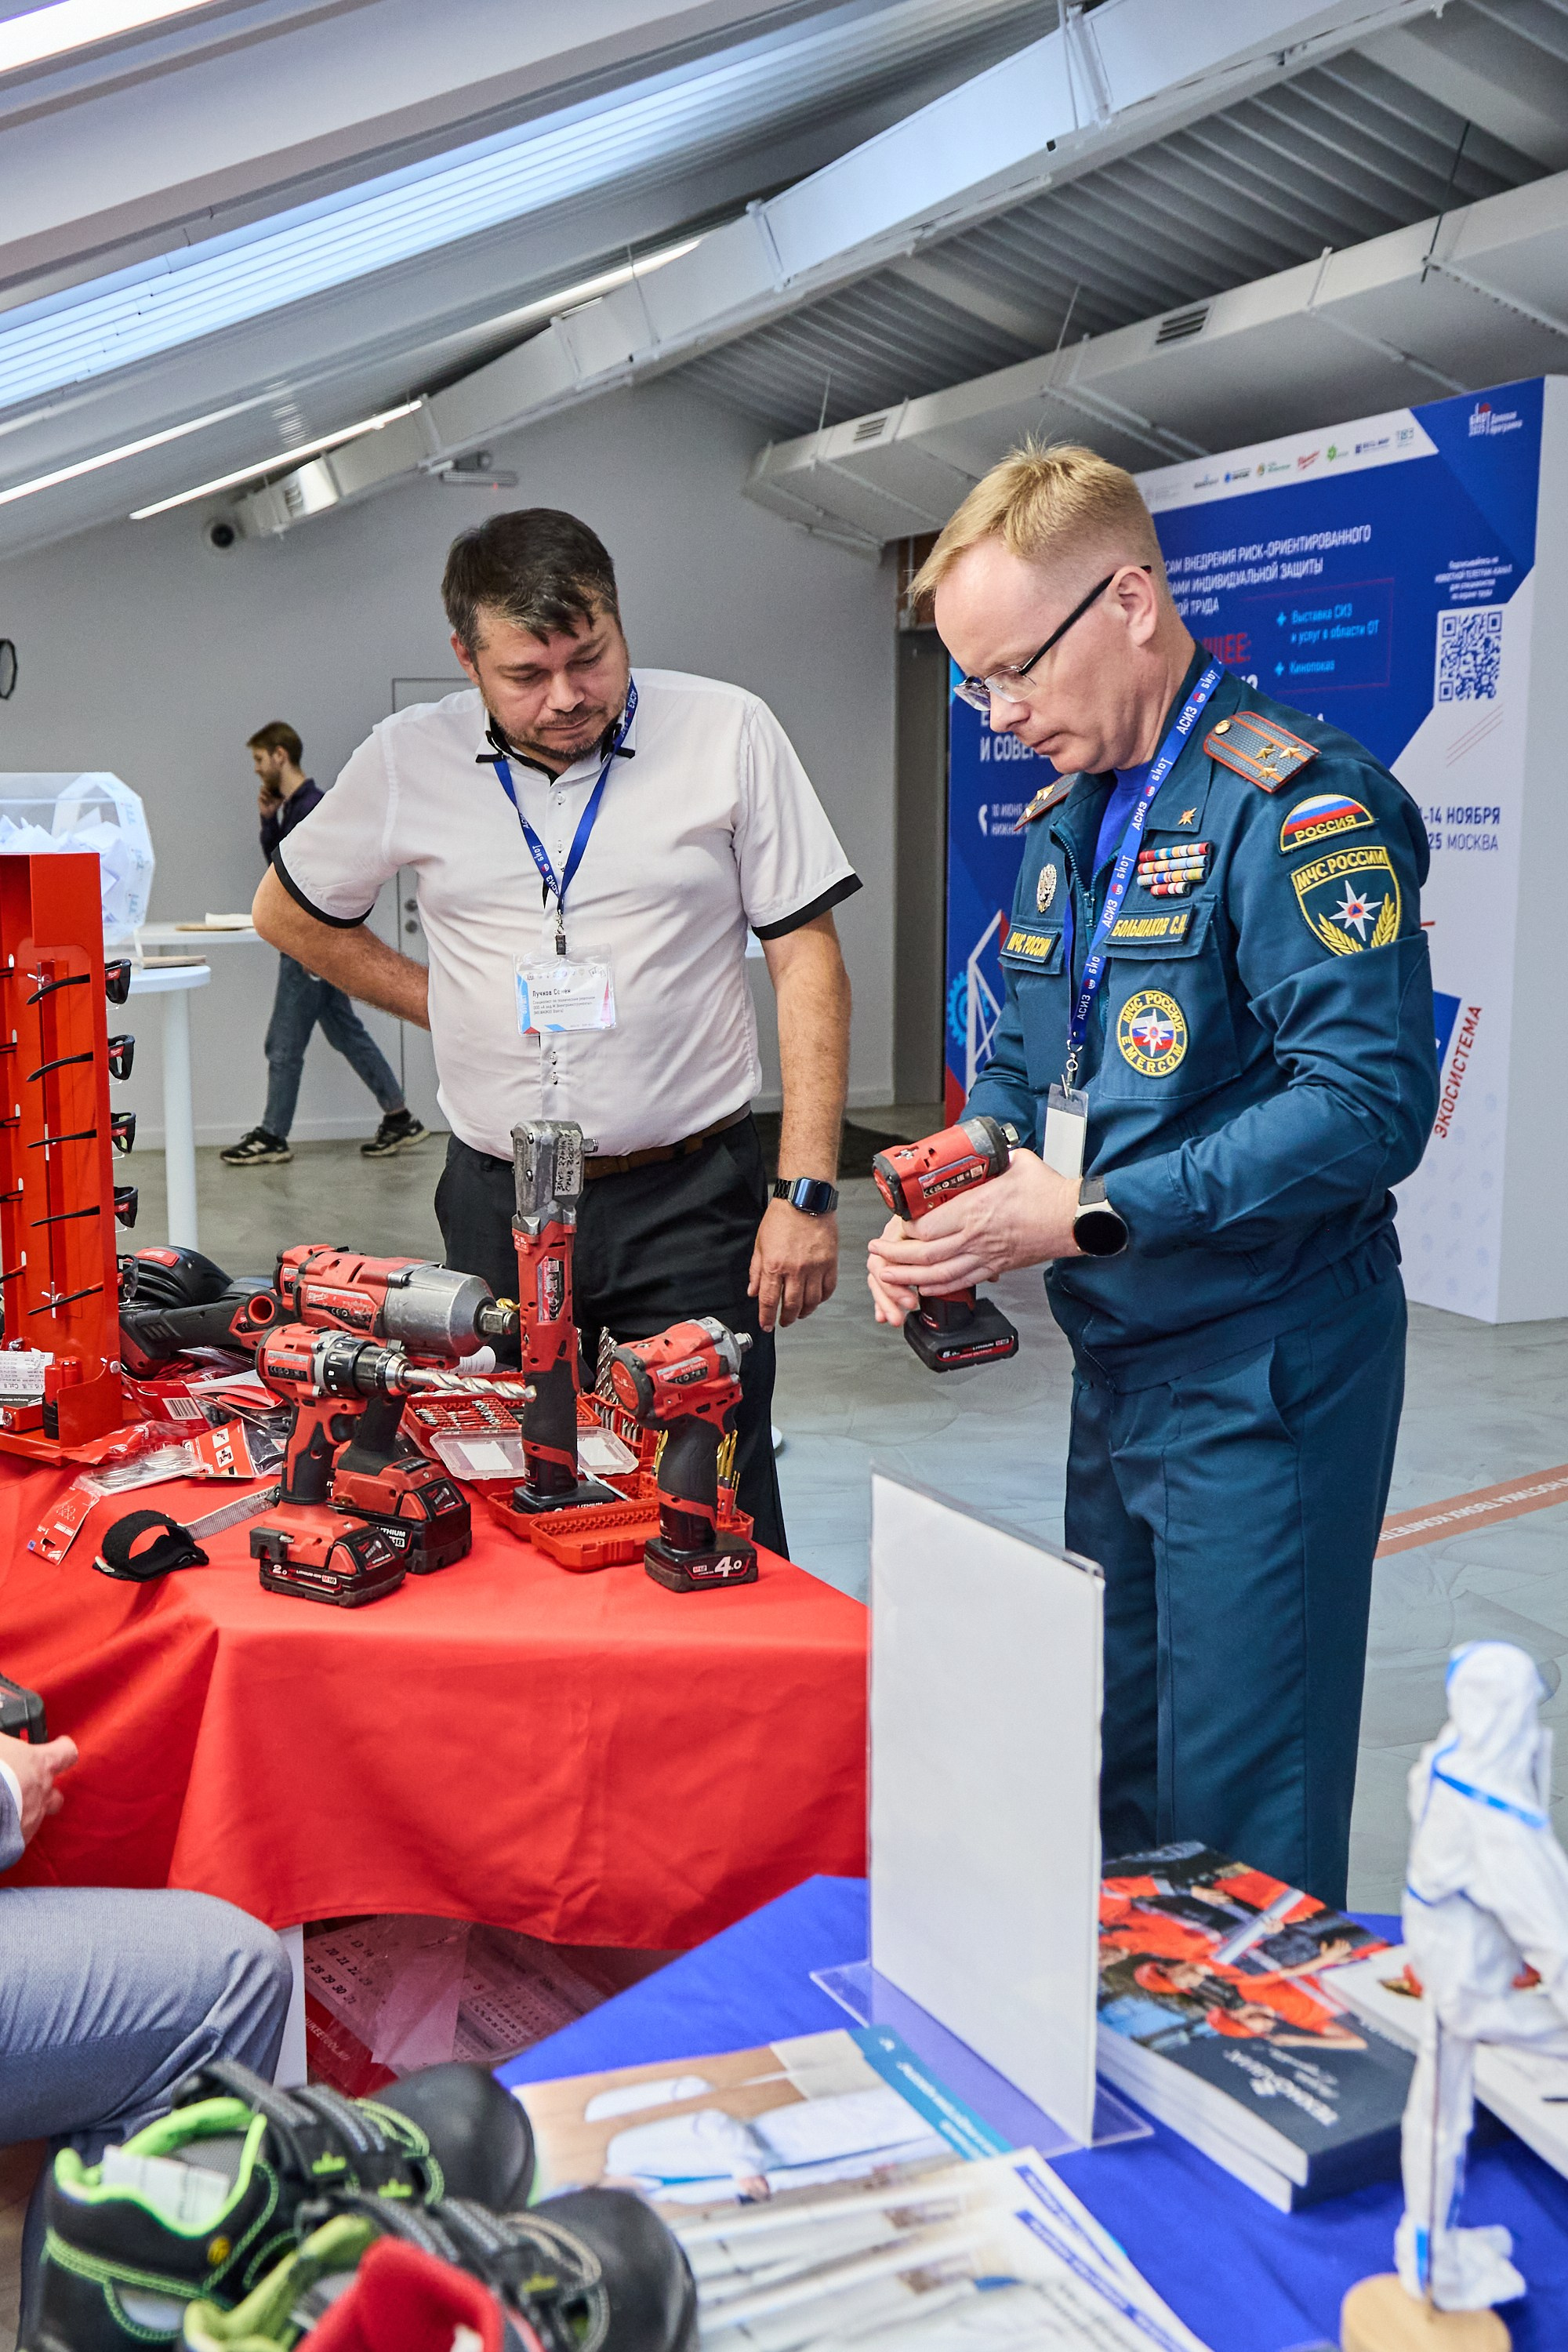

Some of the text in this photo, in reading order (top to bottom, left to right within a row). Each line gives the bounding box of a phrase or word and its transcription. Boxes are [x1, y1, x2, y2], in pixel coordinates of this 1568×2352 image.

[1185, 550, 1237, 573] ВНЕДРЕНИЯ
[1238, 524, 1372, 564] РИСК-ОРИЕНТИРОВАННОГО
[1192, 561, 1279, 593] ИНДИВИДУАЛЬНОЙ
[1279, 557, 1324, 582] ЗАЩИТЫ
[1190, 597, 1220, 616] ТРУДА
[1291, 603, 1354, 624] Выставка СИЗ
[1290, 659, 1336, 674] Кинопоказ
[1176, 706, 1198, 735] АСИЗ
[1131, 800, 1148, 831] АСИЗ
[1294, 814, 1356, 843] РОССИЯ
[1446, 806, 1501, 825] НОЯБРЯ
[1447, 833, 1499, 851] МОСКВА
[1296, 849, 1388, 891] МЧС РОССИИ
[1102, 898, 1119, 929] АСИЗ
[1111, 916, 1171, 938] БОЛЬШАКОВ
[1076, 994, 1091, 1021] АСИЗ
[1122, 993, 1184, 1033] МЧС РОССИИ
[1121, 1035, 1183, 1073] EMERCOM
[1434, 1005, 1483, 1138] ЭКОСИСТЕМА
[272, 1564, 287, 1576] 2.0
[714, 1555, 742, 1577] 4.0
[325, 1947, 339, 1957] 20
[310, 1965, 325, 1975] 28
[321, 1974, 336, 1984] 29
[332, 1984, 347, 1994] 30
